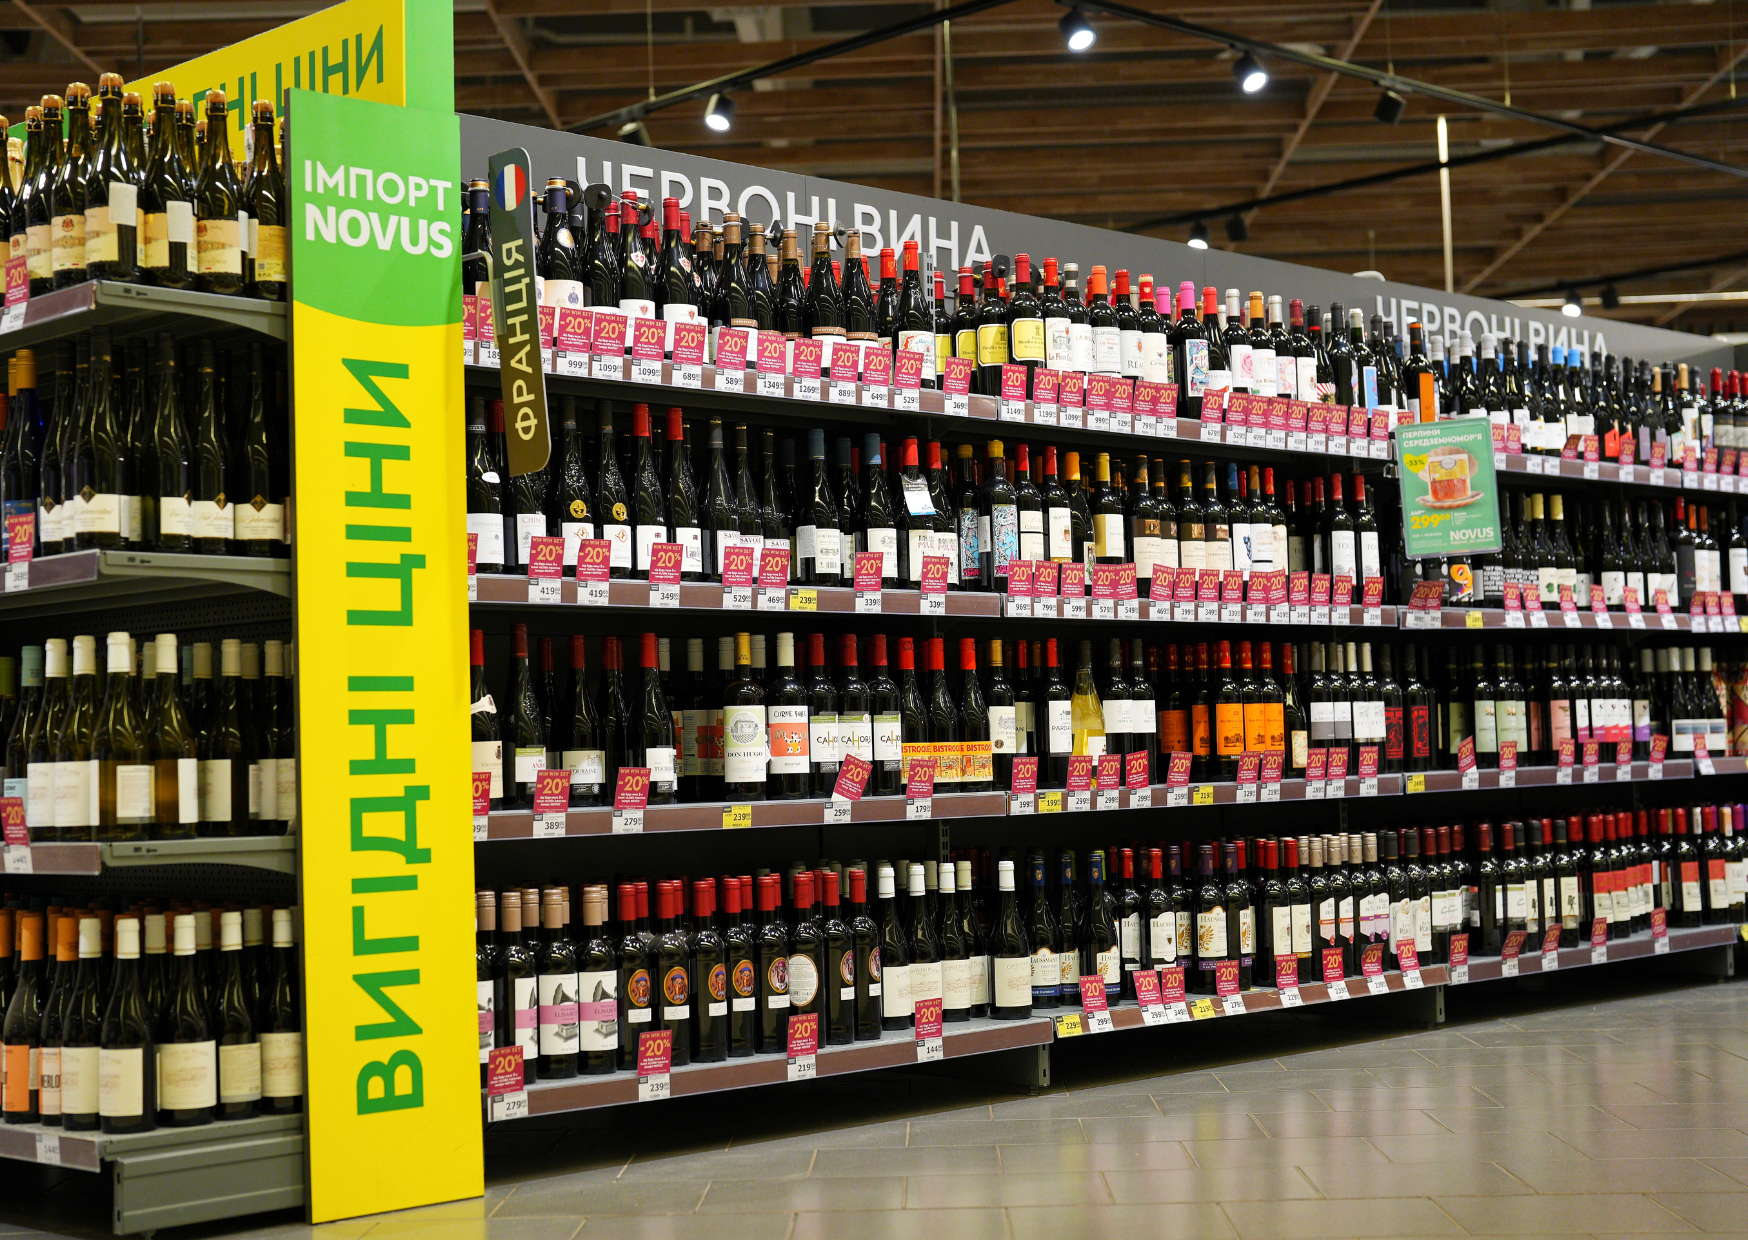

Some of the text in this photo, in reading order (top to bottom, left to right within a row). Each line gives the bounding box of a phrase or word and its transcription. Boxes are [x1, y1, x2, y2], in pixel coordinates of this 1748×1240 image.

[304, 160, 452, 211] ІМПОРТ
[576, 156, 991, 272] ЧЕРВОНІ ВИНА
[305, 203, 453, 258] NOVUS
[560, 317, 591, 333] -20%
[595, 322, 625, 338] -20%
[1376, 295, 1608, 369] ЧЕРВОНІ ВИНА
[502, 238, 538, 441] ФРАНЦІЯ
[635, 327, 664, 343] -20%
[676, 331, 704, 347] -20%
[719, 336, 746, 351] -20%
[759, 342, 785, 357] -20%
[795, 346, 821, 360] -20%
[833, 351, 858, 366] -20%
[865, 355, 889, 370] -20%
[897, 359, 921, 373] -20%
[946, 365, 970, 379] -20%
[1003, 372, 1026, 386] -20%
[1036, 375, 1057, 389] -20%
[1062, 378, 1083, 392] -20%
[1088, 381, 1110, 395] -20%
[1112, 384, 1132, 398] -20%
[1402, 429, 1440, 438] ПЕРЛИНИ
[9, 524, 34, 543] -20%
[1450, 527, 1494, 540] NOVUS
[532, 545, 563, 560] -20%
[579, 547, 610, 563] -20%
[652, 552, 681, 567] -20%
[725, 555, 752, 570] -20%
[761, 557, 788, 571] -20%
[856, 560, 882, 574] -20%
[923, 564, 947, 578] -20%
[1010, 567, 1032, 580] -20%
[1036, 568, 1057, 581] -20%
[1062, 570, 1084, 583] -20%
[1224, 577, 1242, 589] -20%
[342, 358, 432, 1115] ВИГІДНІ ЦІНИ
[1014, 764, 1036, 778] -20%
[1069, 762, 1091, 775] -20%
[1099, 762, 1120, 774] -20%
[1127, 759, 1147, 773] -20%
[1171, 759, 1190, 772] -20%
[843, 765, 870, 782] -20%
[910, 767, 934, 781] -20%
[537, 778, 568, 794] -20%
[619, 776, 648, 791] -20%
[1217, 968, 1238, 980] -20%
[1278, 962, 1296, 974] -20%
[1136, 977, 1158, 990] -20%
[1163, 974, 1184, 987] -20%
[1082, 983, 1104, 996] -20%
[916, 1007, 941, 1022] -20%
[790, 1022, 816, 1038] -20%
[640, 1039, 670, 1056] -20%
[490, 1055, 522, 1074] -20%
